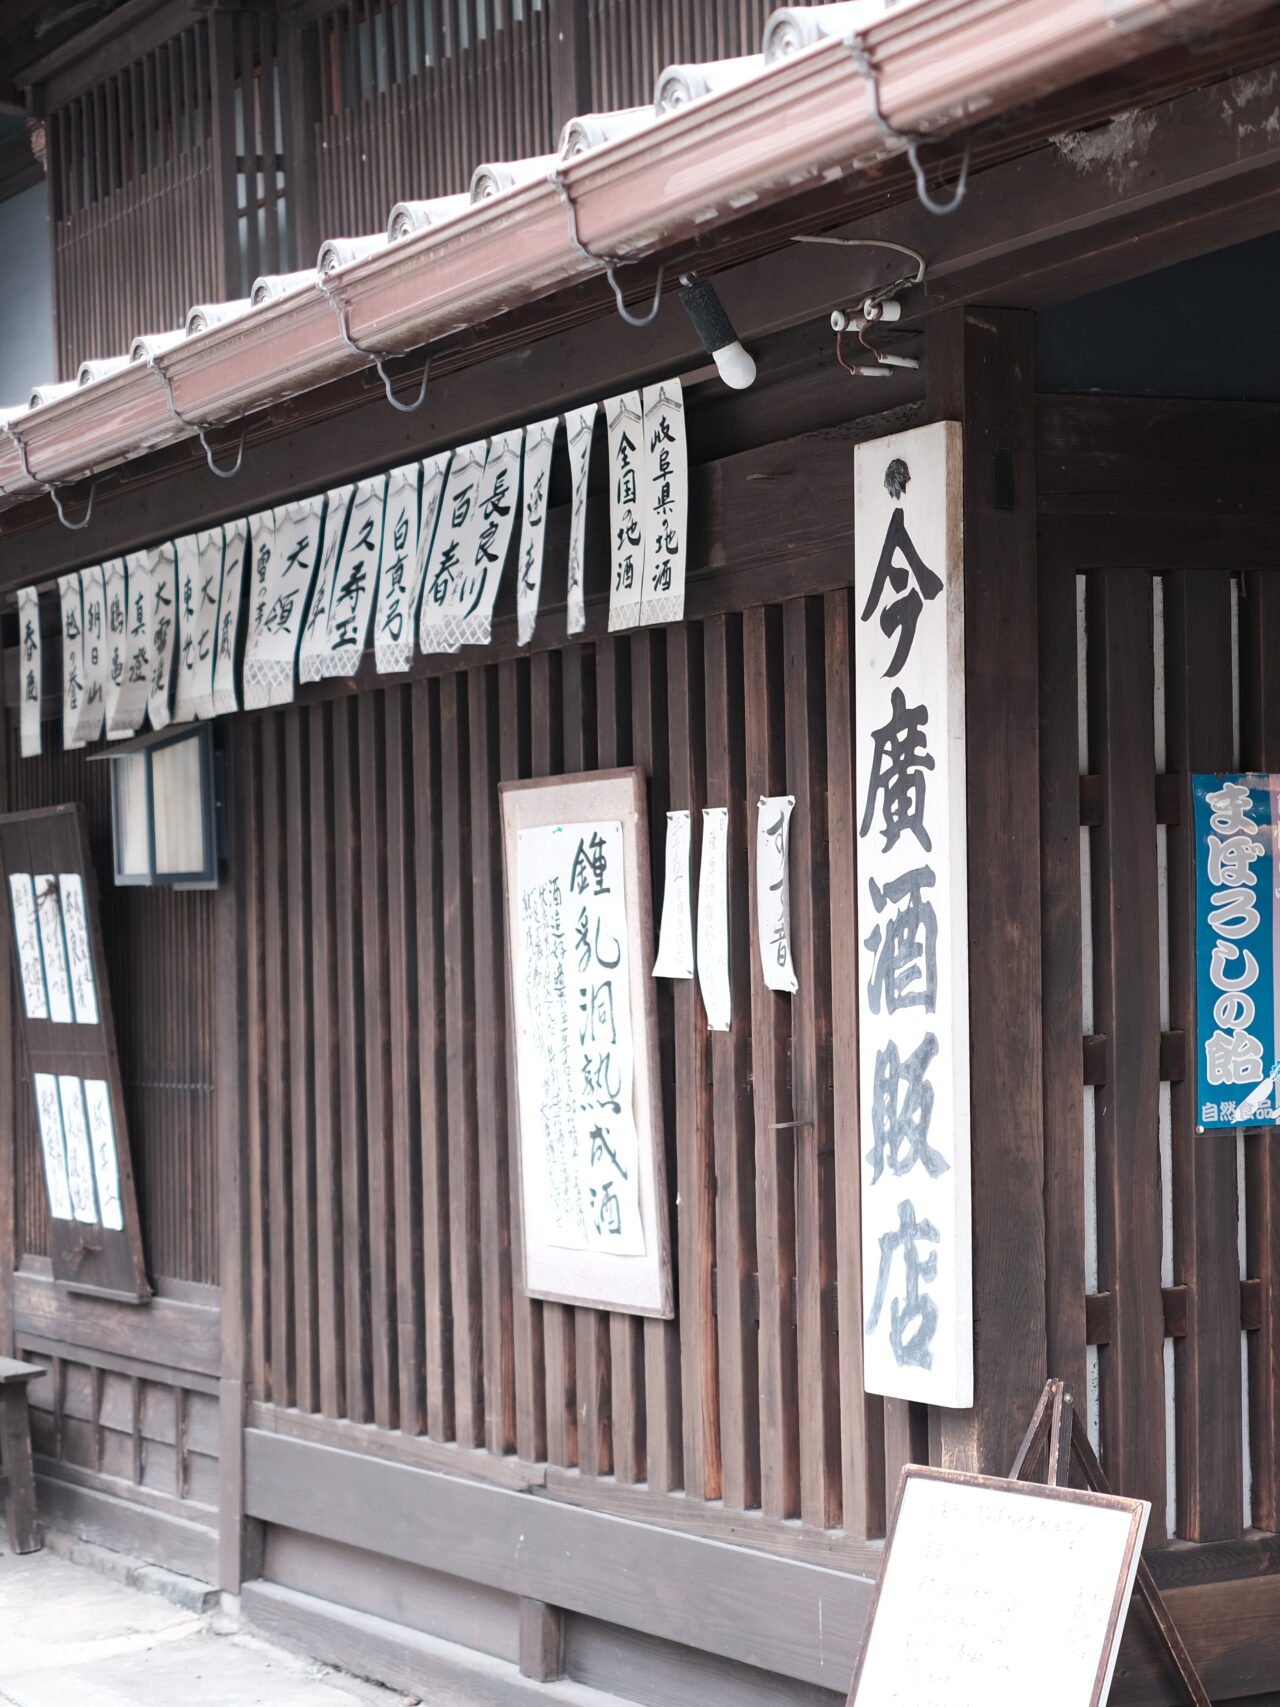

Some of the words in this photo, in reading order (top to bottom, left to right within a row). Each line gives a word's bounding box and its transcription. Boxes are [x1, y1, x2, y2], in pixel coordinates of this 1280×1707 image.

[428, 483, 474, 606] 百春
[460, 469, 511, 619] 長良川
[615, 431, 641, 592] 全国の地酒
[650, 415, 679, 592] 岐阜県の地酒
[197, 575, 216, 661] 大七
[264, 535, 309, 634] 天領
[332, 515, 375, 651] 久寿玉
[382, 507, 409, 642] 白真弓
[87, 601, 103, 705] 朝日山
[858, 507, 950, 1371] 今廣酒販店
[1204, 781, 1265, 1086] まぼろしの飴
[1201, 1099, 1273, 1123] 自然食品
